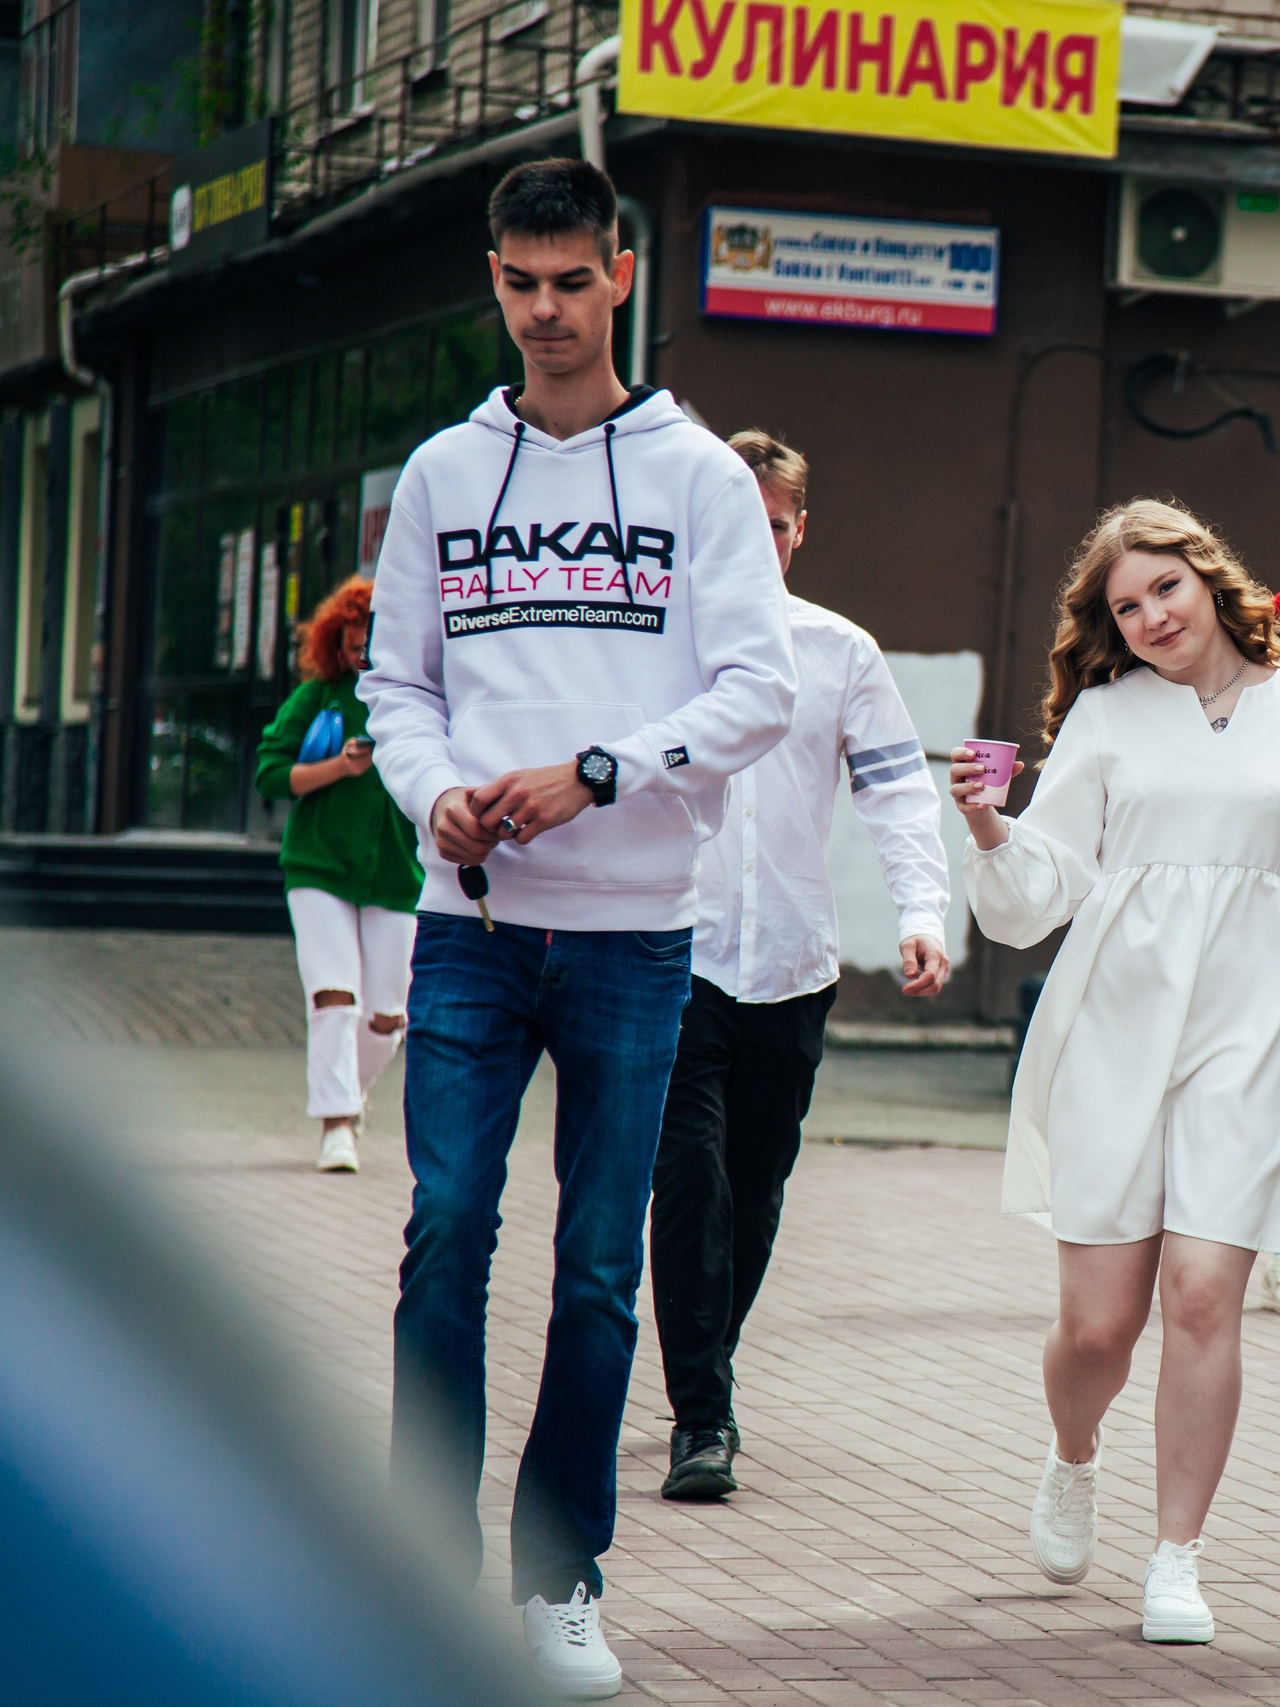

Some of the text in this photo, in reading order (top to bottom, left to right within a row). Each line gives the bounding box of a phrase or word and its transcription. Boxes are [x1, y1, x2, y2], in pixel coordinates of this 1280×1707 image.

[636, 0, 1098, 116] КУЛИНАРИЯ
[764, 297, 923, 328] www.ekburg.ru
[436, 521, 676, 572] DAKAR
[558, 566, 671, 599] TEAM
[449, 605, 659, 633] DiverseExtremeTeam.com
